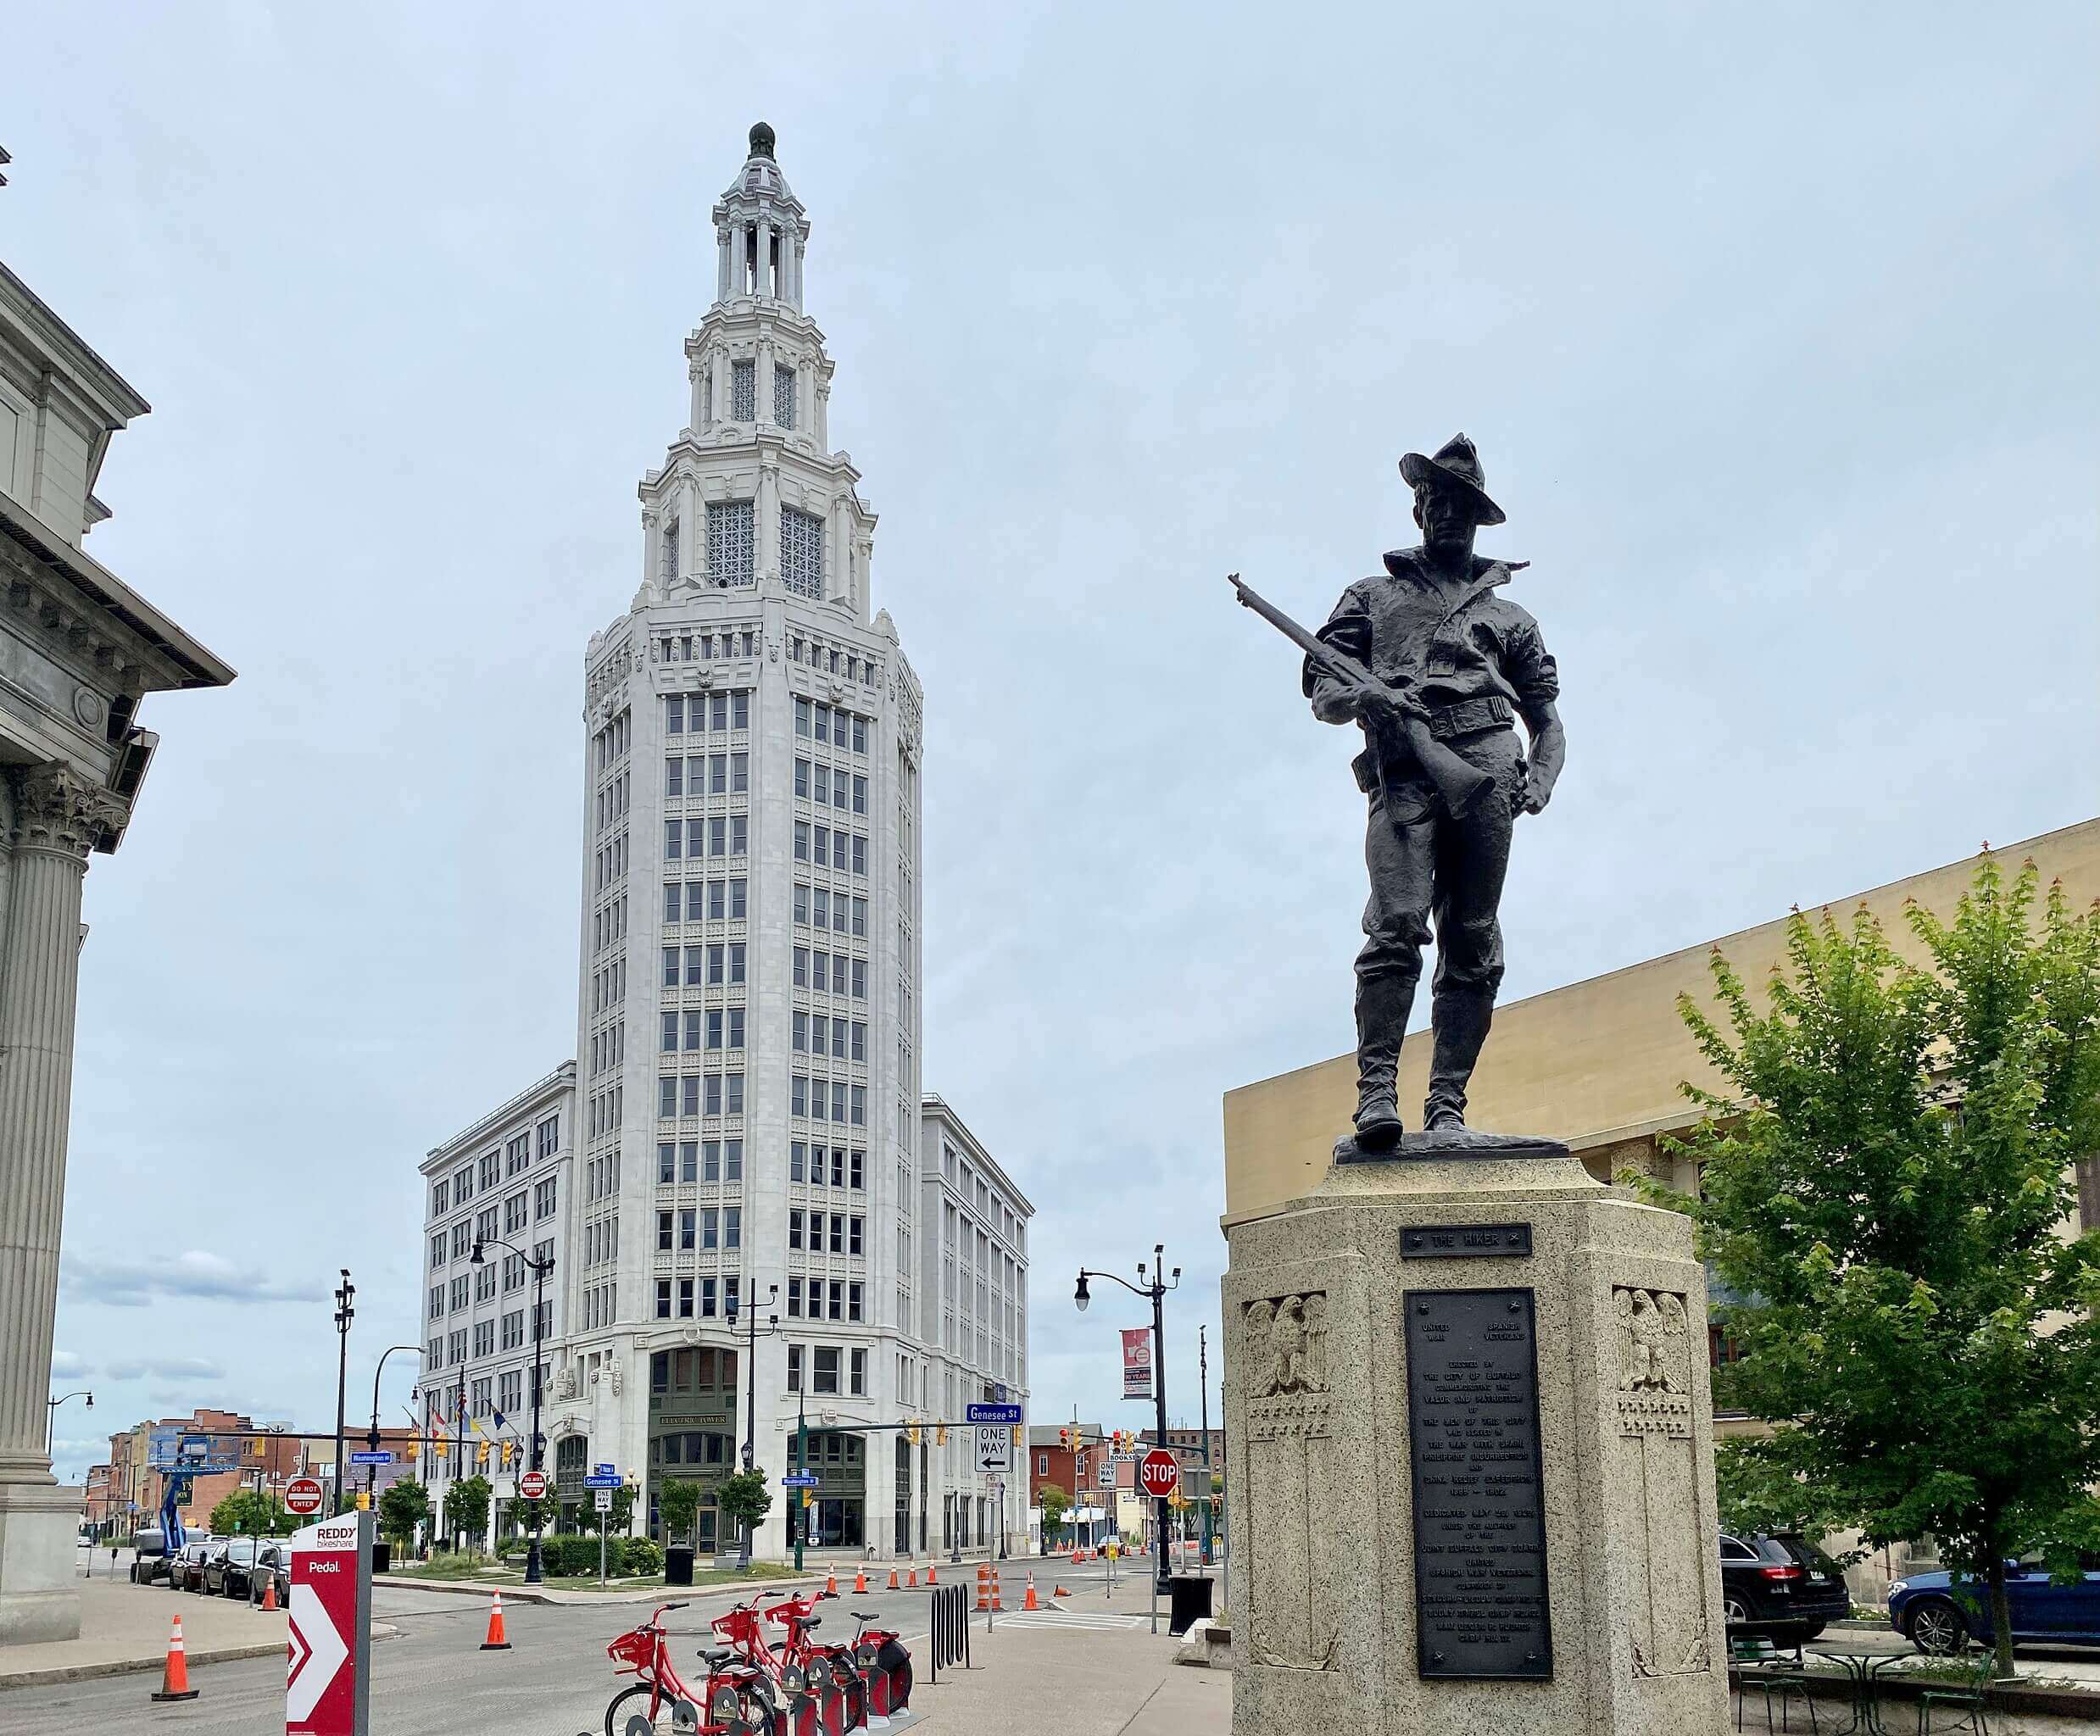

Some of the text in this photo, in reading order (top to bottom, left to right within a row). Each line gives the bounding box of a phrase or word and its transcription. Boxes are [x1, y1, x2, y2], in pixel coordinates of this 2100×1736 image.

[1431, 1234, 1499, 1247] THE HIKER
[971, 1407, 1017, 1420] Genesee St
[981, 1428, 1006, 1439] ONE
[980, 1443, 1006, 1454] WAY
[1144, 1464, 1175, 1482] STOP
[318, 1527, 356, 1538] REDDY
[309, 1561, 341, 1572] Pedal.
